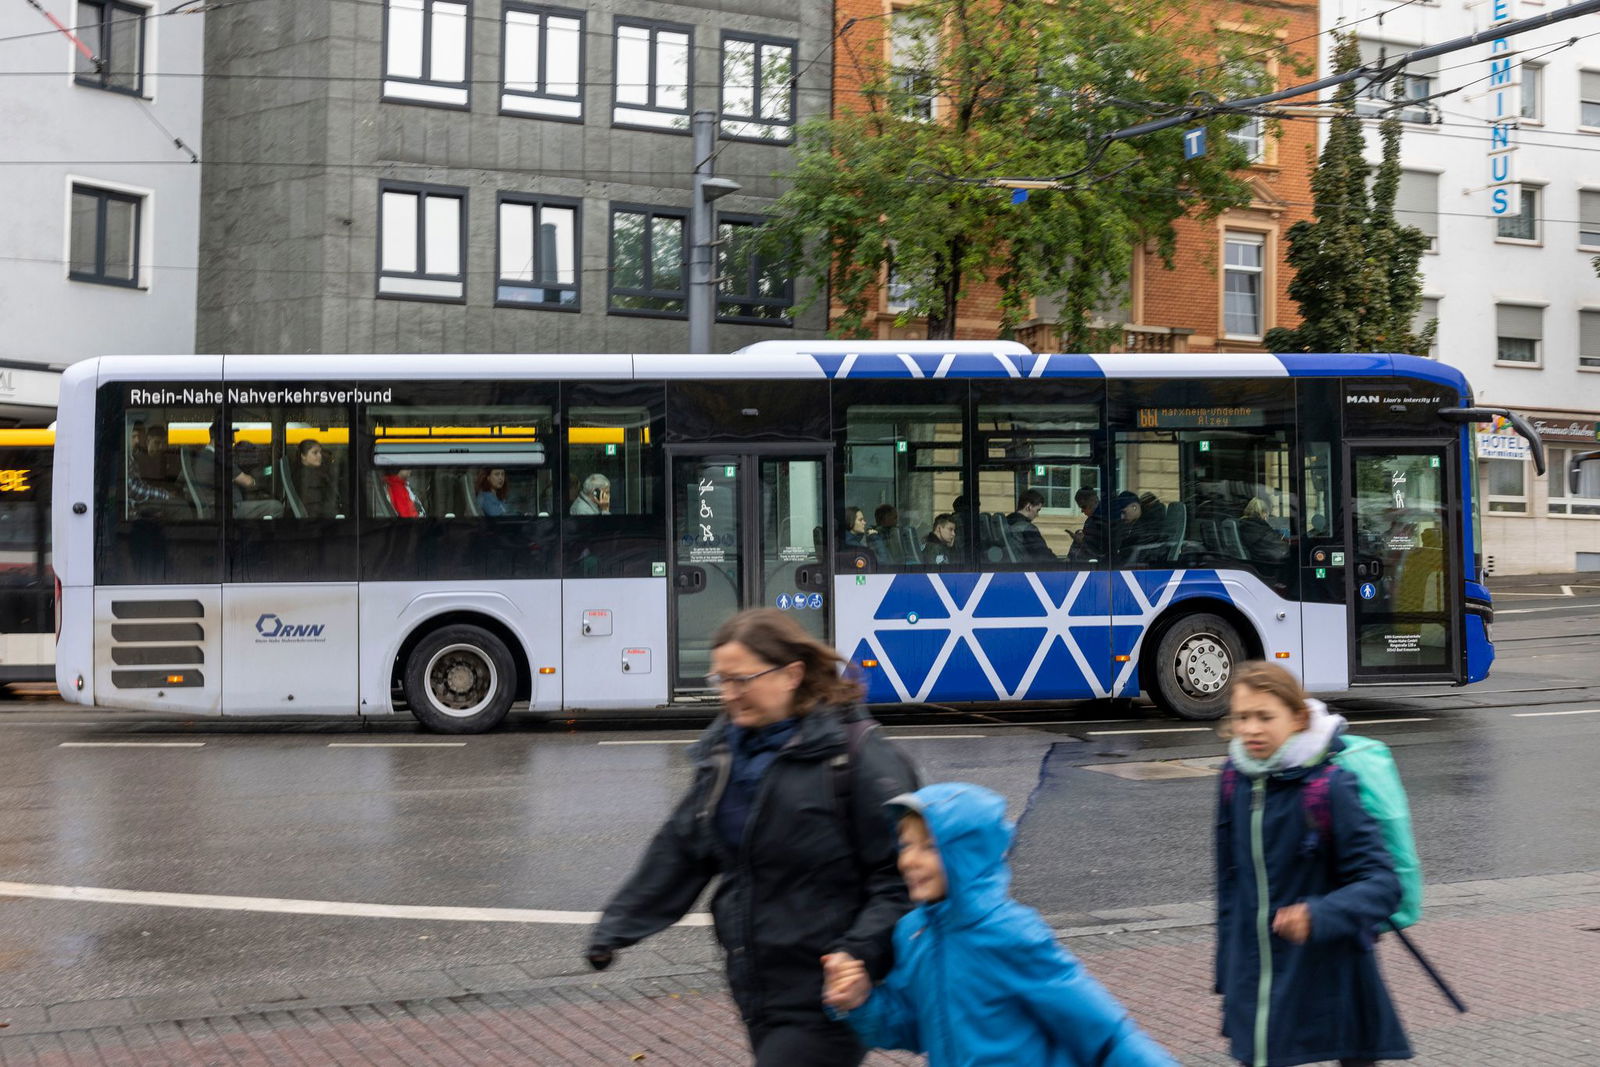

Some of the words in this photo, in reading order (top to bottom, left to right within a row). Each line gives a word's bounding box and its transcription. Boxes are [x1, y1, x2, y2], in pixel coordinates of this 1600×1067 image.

[1185, 130, 1202, 155] T
[130, 388, 223, 405] Rhein-Nahe
[228, 387, 392, 404] Nahverkehrsverbund
[1346, 395, 1380, 404] MAN
[1482, 434, 1525, 450] HOTEL
[279, 624, 325, 637] RNN
